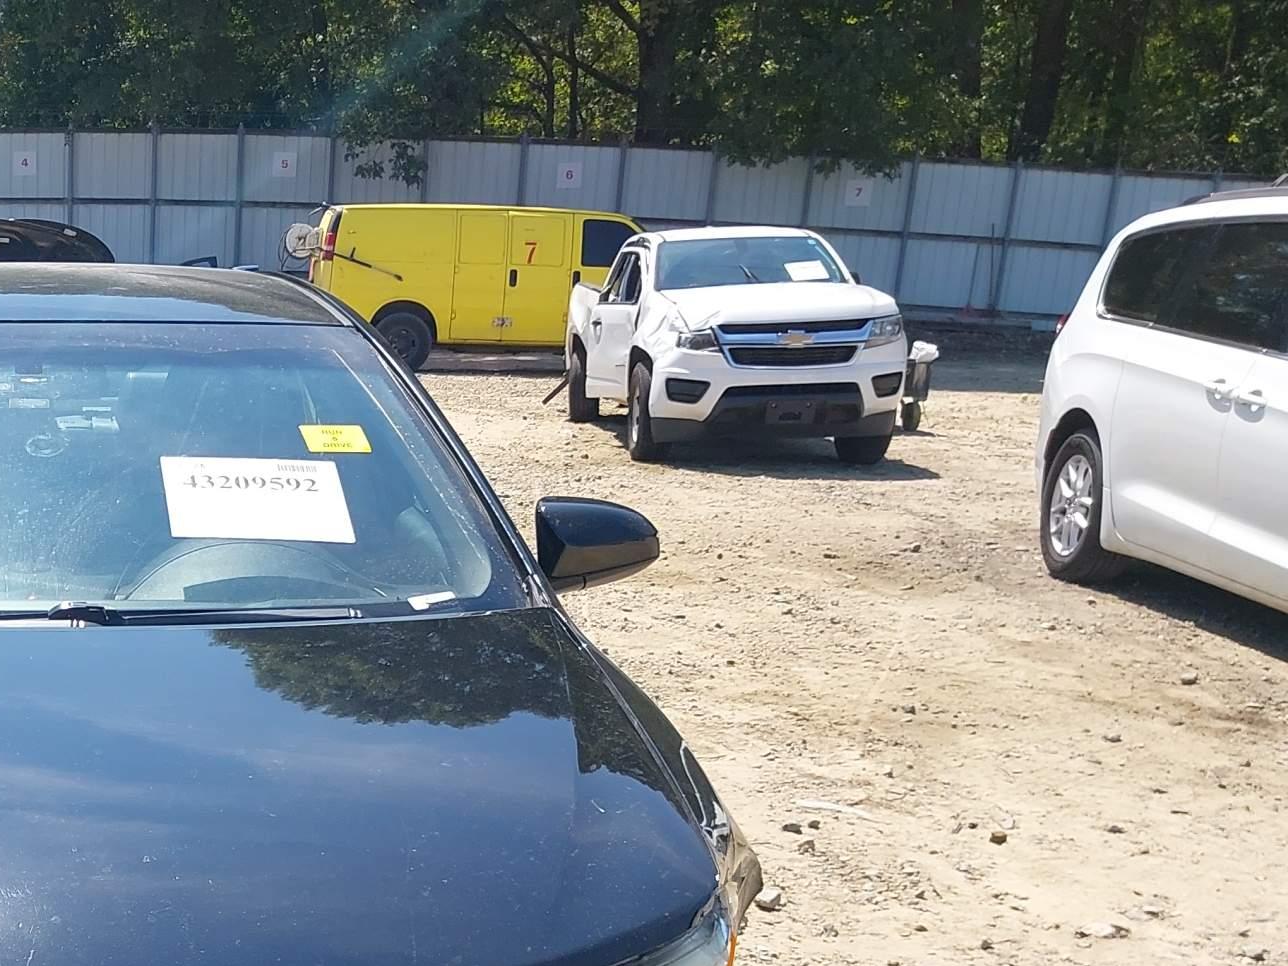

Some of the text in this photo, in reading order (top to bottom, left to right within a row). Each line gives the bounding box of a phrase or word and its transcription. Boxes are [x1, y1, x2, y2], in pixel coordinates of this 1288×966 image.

[20, 158, 29, 167] 4
[281, 159, 289, 169] 5
[565, 169, 574, 180] 6
[855, 187, 864, 197] 7
[524, 242, 538, 265] 7
[183, 474, 320, 492] 43209592
